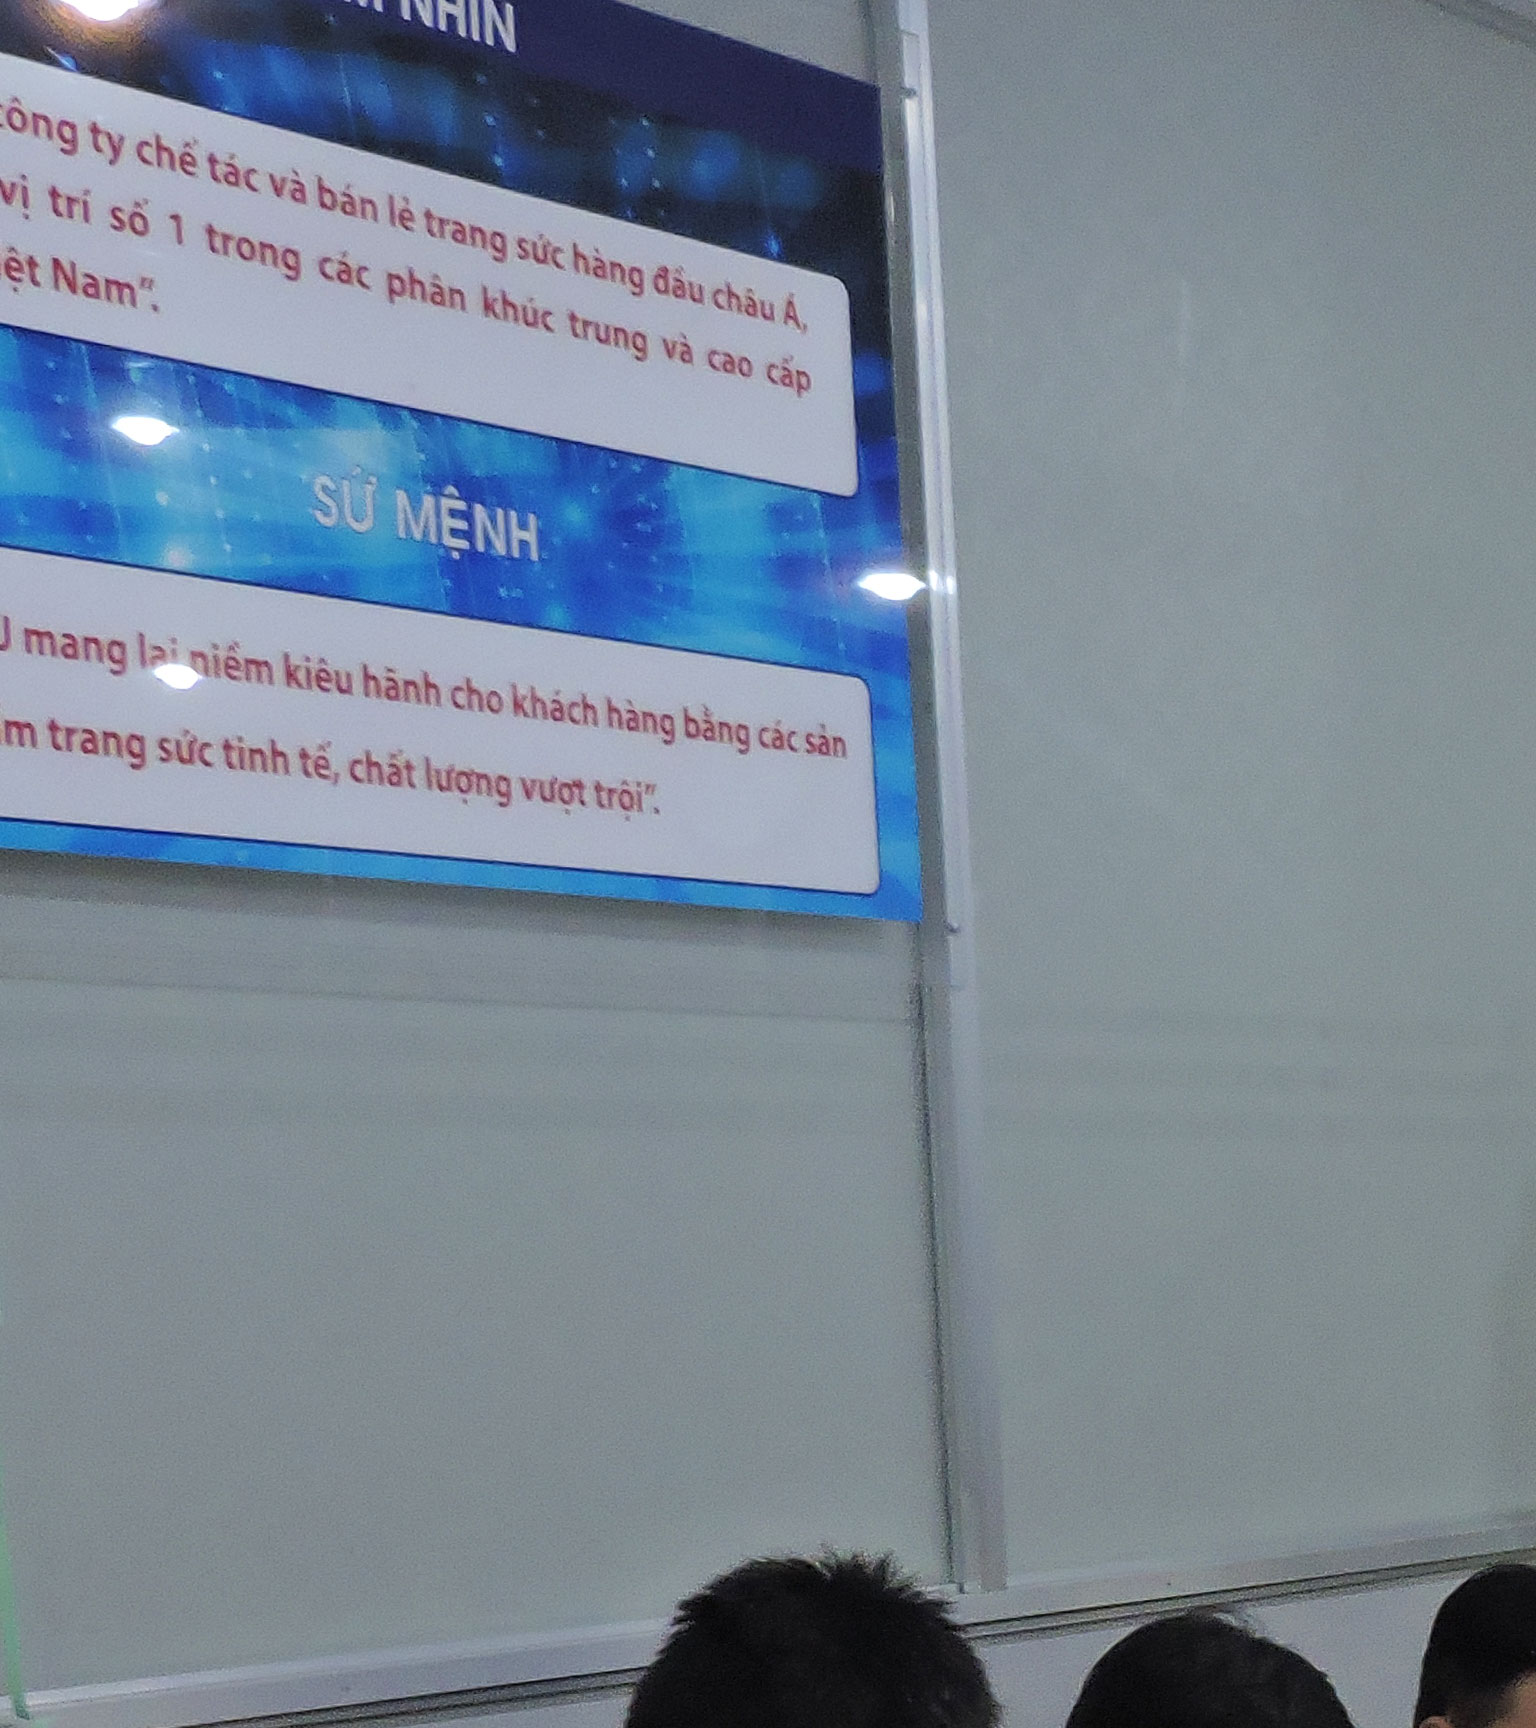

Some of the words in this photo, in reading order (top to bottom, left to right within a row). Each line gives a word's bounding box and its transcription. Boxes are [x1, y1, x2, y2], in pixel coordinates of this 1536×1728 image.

[0, 96, 78, 156] ông
[90, 121, 125, 166] ty
[208, 152, 261, 192] tác
[268, 167, 307, 204] và
[424, 207, 508, 264] trang
[573, 243, 645, 297] hàng
[713, 281, 775, 321] châu
[0, 246, 41, 294] ệt
[169, 213, 184, 245] 1
[206, 223, 301, 282] trong
[319, 250, 371, 291] các
[482, 284, 554, 333] khúc
[567, 310, 648, 362] trung
[661, 332, 693, 365] và
[707, 350, 753, 378] cao
[395, 484, 540, 562] MỆNH
[24, 627, 126, 676] mang
[283, 651, 354, 696] kiêu
[450, 677, 503, 714] cho
[511, 682, 599, 727] khách
[606, 696, 675, 745] hàng
[758, 719, 798, 753] các
[47, 719, 146, 770] trang
[222, 737, 290, 775] tinh
